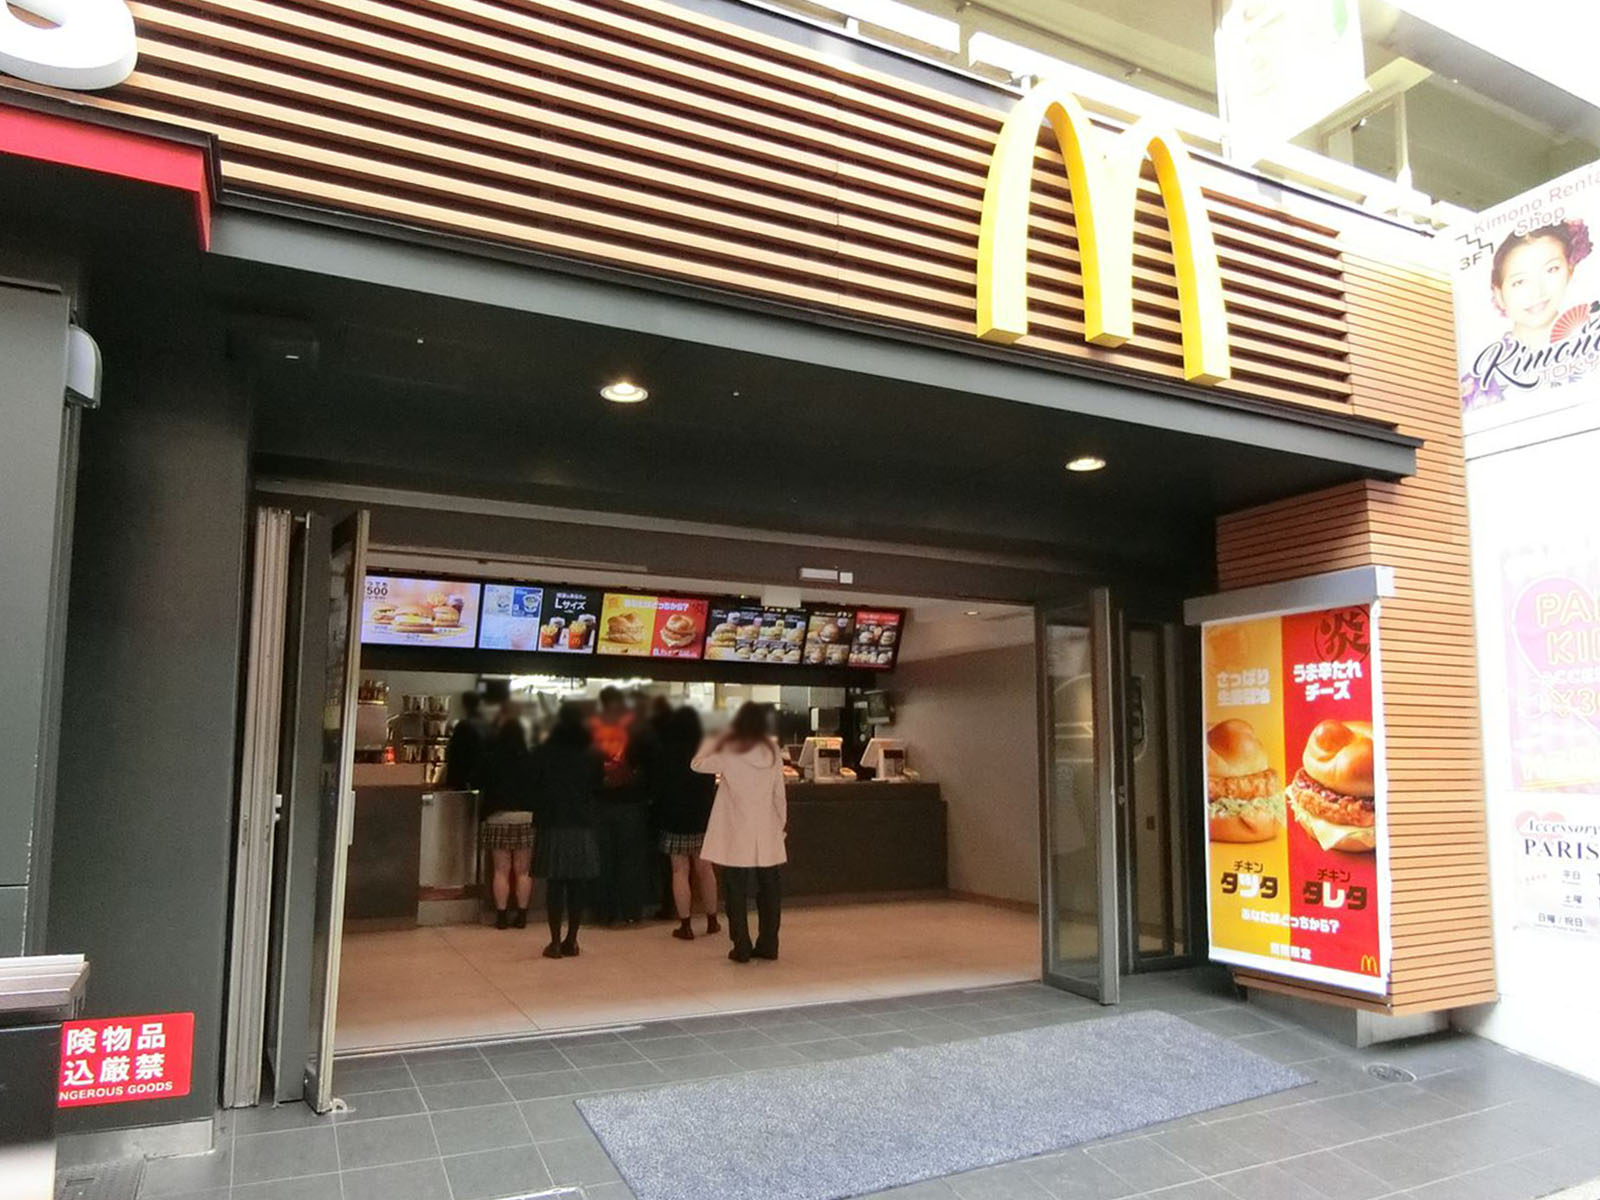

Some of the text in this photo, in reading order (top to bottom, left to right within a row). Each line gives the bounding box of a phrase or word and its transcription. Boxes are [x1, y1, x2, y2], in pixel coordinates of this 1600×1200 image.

[1472, 198, 1543, 235] Kimono
[1515, 207, 1566, 235] Shop
[1459, 251, 1483, 271] 3F
[366, 586, 388, 596] 500
[554, 597, 587, 610] Lサイズ
[1536, 590, 1600, 628] PA
[1293, 659, 1363, 684] うま辛たれ
[1305, 680, 1351, 702] チーズ
[1524, 838, 1600, 861] PARIS
[1233, 860, 1264, 874] チキン
[1316, 868, 1351, 883] チキン
[1221, 872, 1279, 899] タツタ
[1303, 880, 1368, 910] タレタ
[127, 1081, 173, 1095] GOODS
